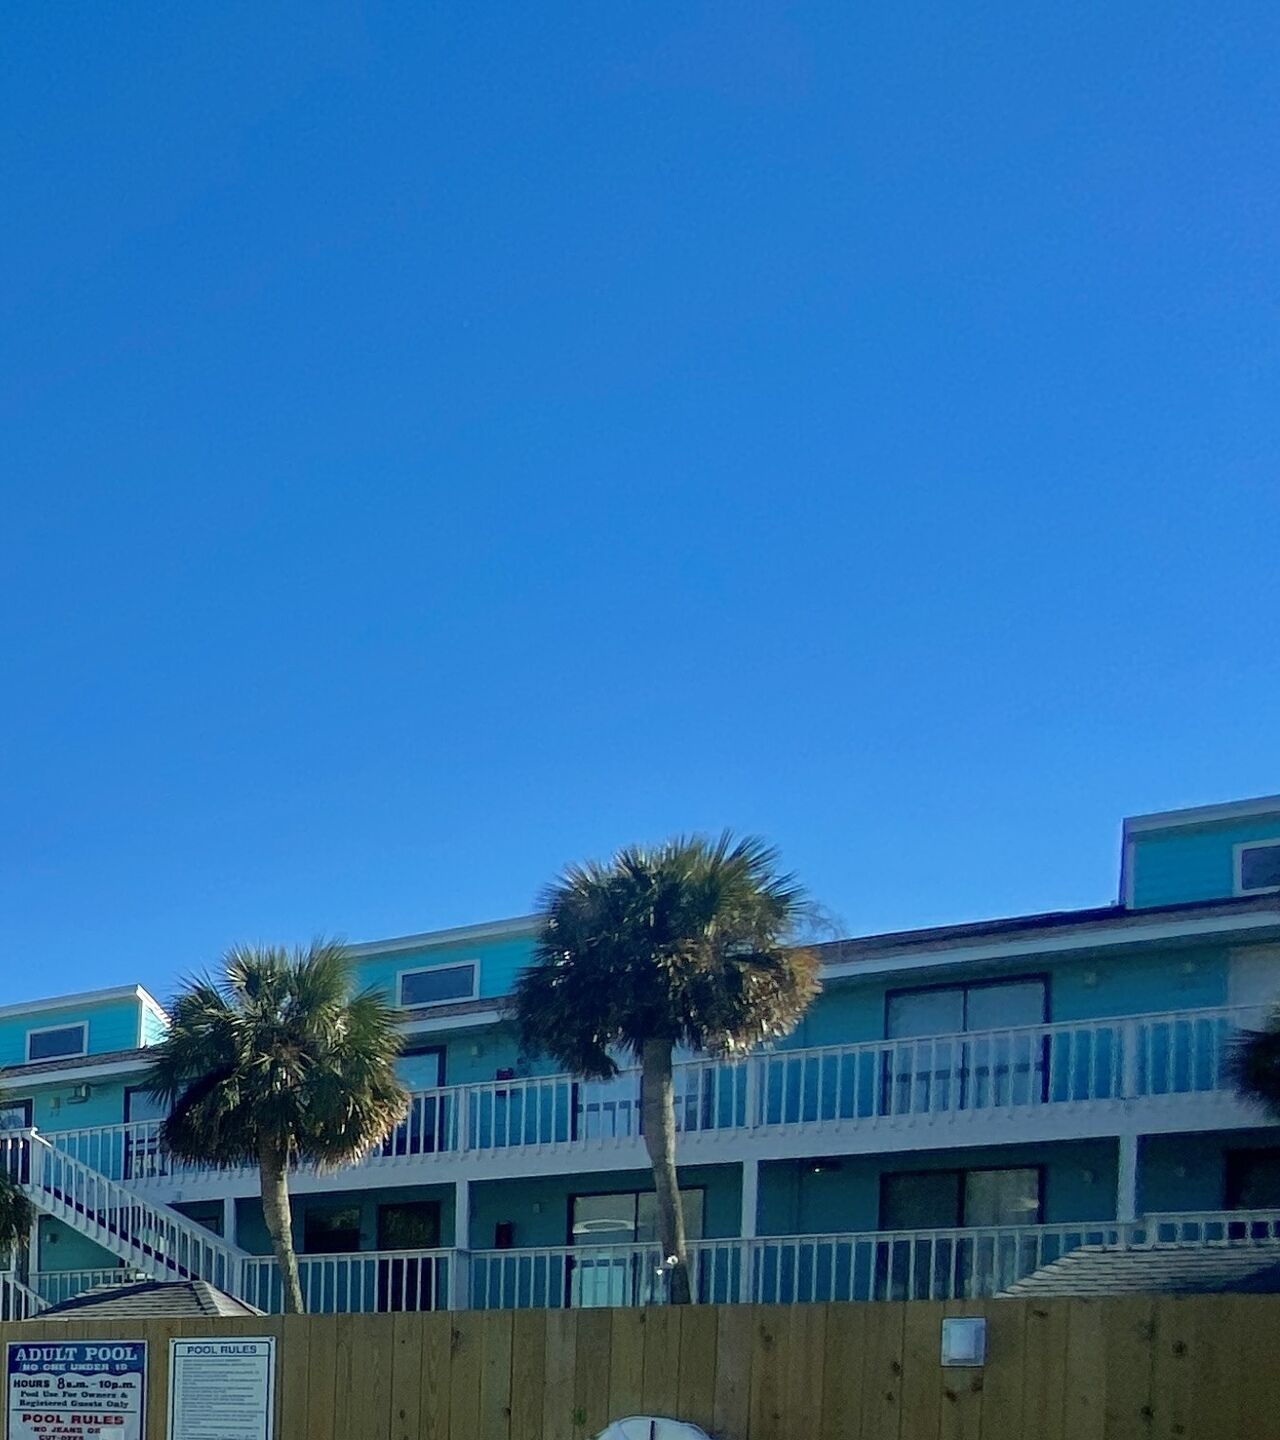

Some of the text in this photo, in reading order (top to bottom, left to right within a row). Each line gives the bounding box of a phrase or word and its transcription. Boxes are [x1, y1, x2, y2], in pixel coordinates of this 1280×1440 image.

[15, 1347, 138, 1361] ADULT POOL
[187, 1345, 257, 1354] POOL RULES
[22, 1363, 39, 1372] NO
[42, 1363, 66, 1371] ONE
[70, 1363, 109, 1371] UNDER
[13, 1379, 50, 1388] HOURS
[81, 1391, 117, 1399] Owners
[19, 1399, 68, 1408] Registered
[106, 1400, 129, 1409] Only
[22, 1413, 125, 1425] POOL RULES
